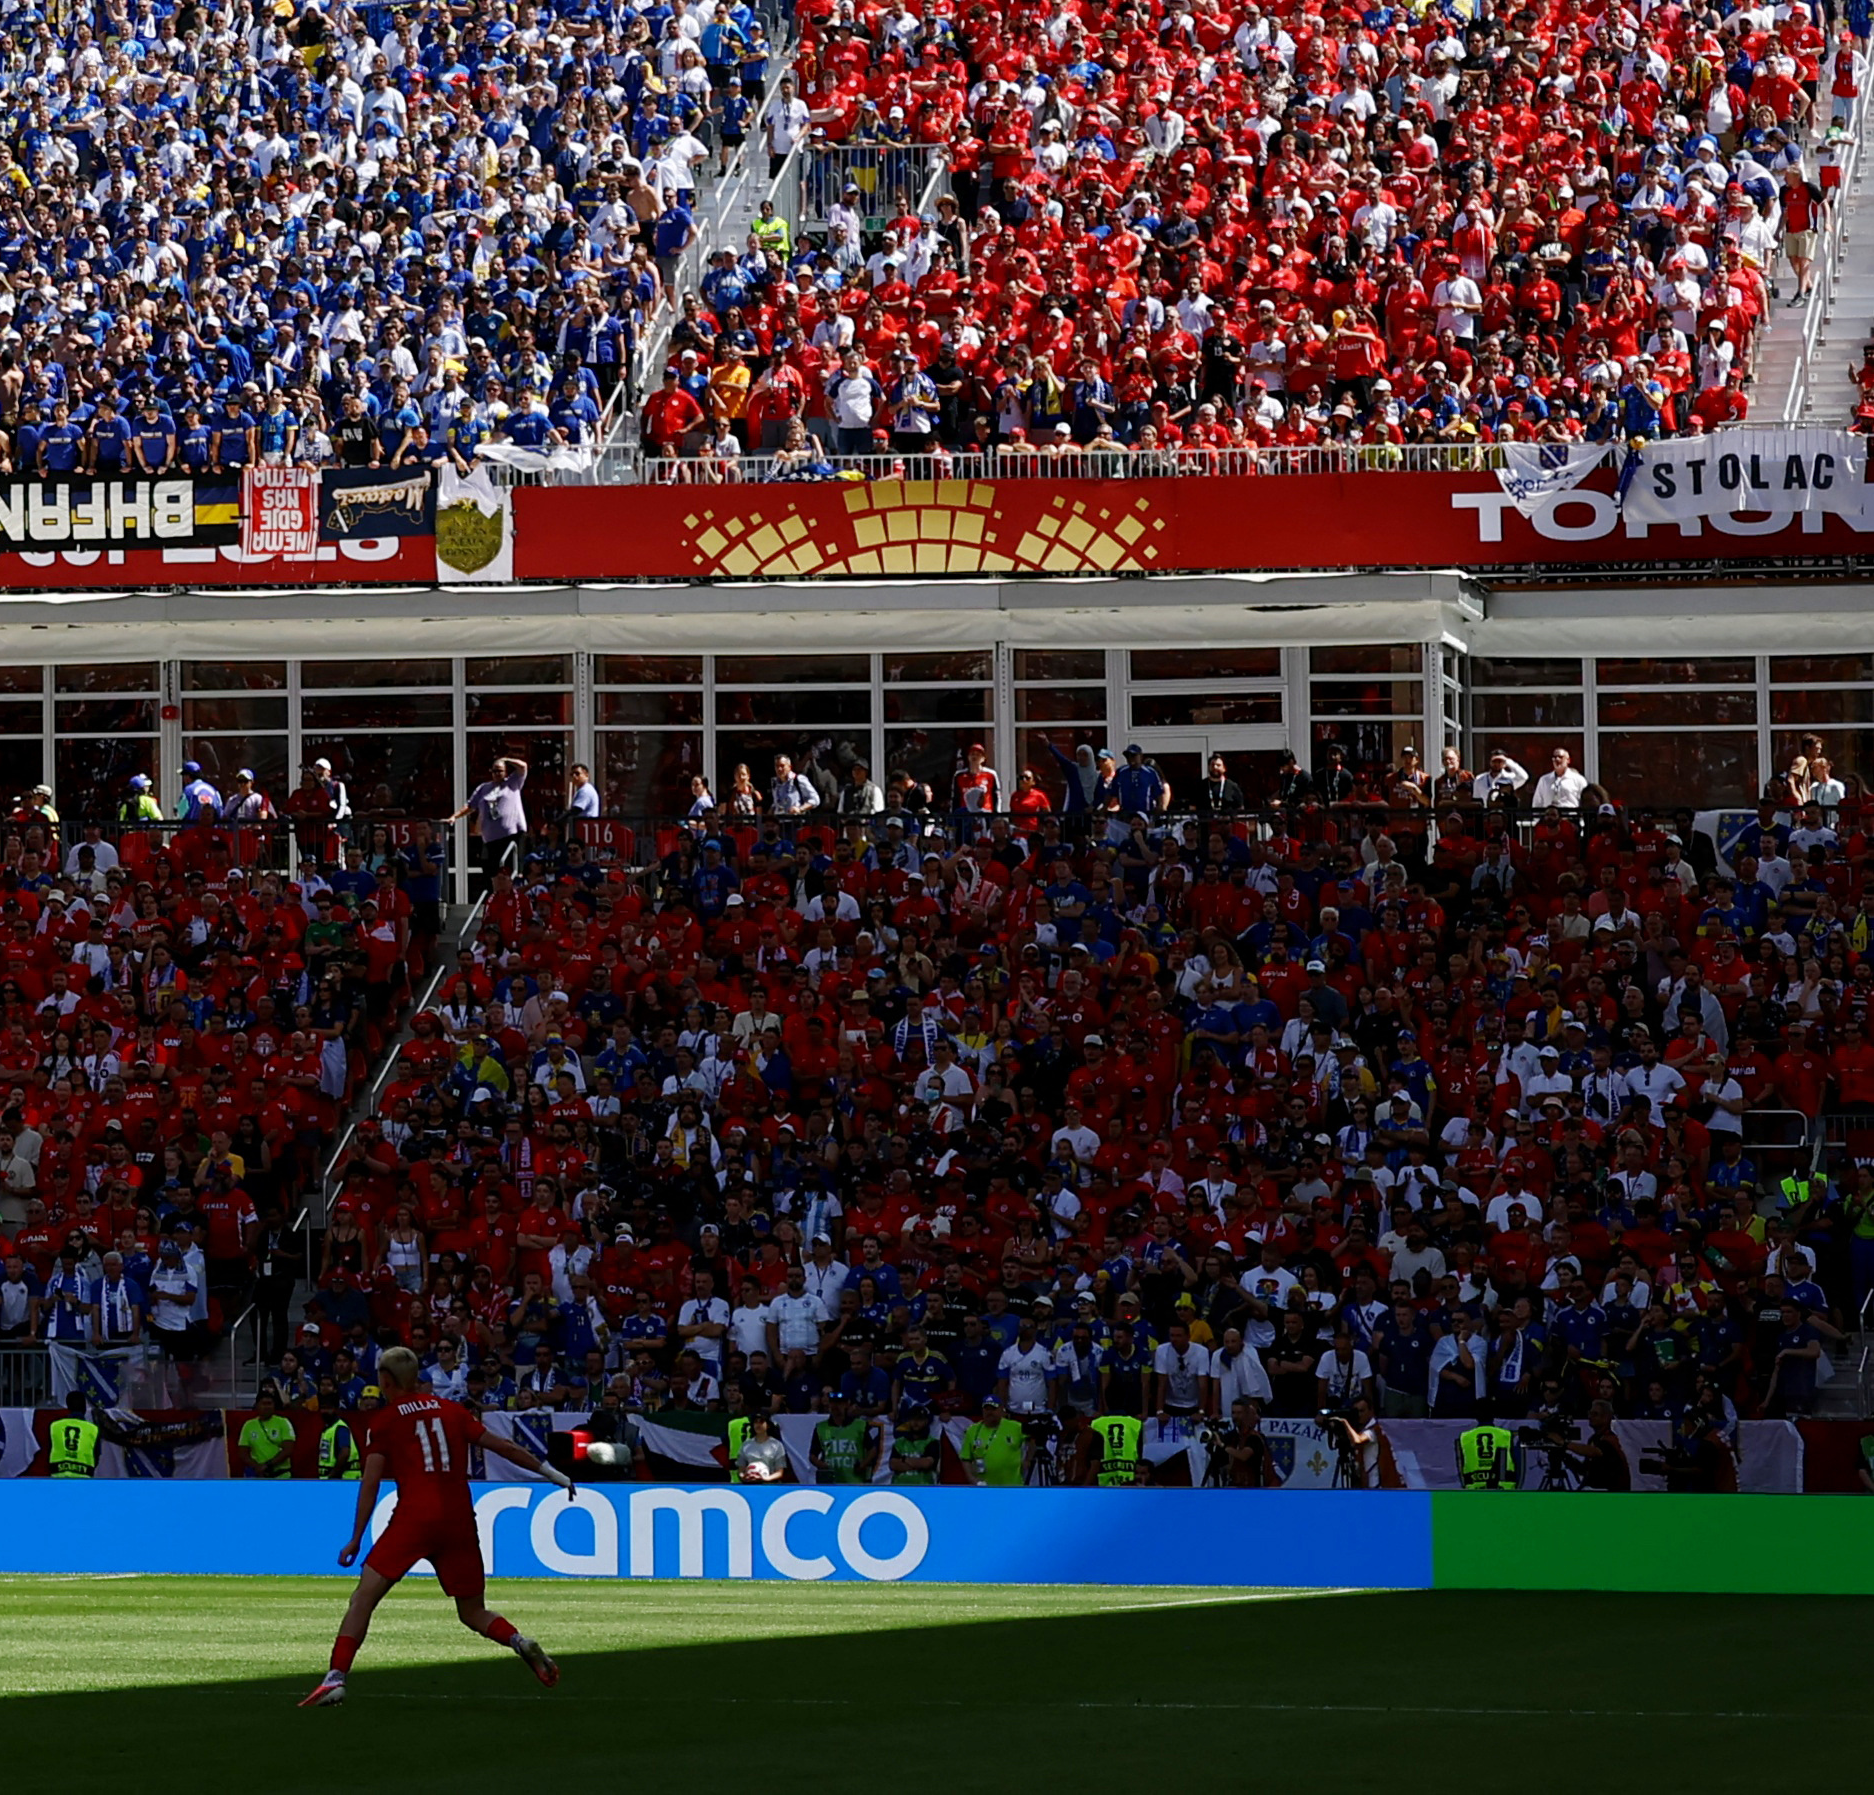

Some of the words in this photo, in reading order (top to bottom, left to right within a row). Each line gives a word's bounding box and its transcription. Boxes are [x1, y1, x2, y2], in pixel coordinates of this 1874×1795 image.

[1654, 452, 1836, 497] STOLAC
[263, 488, 300, 508] NAS
[259, 508, 303, 528] GDJE
[252, 531, 309, 552] NEMA
[582, 821, 614, 845] 116
[397, 1399, 442, 1416] MILLAR
[1270, 1420, 1324, 1442] PAZAR
[414, 1416, 451, 1473] 11
